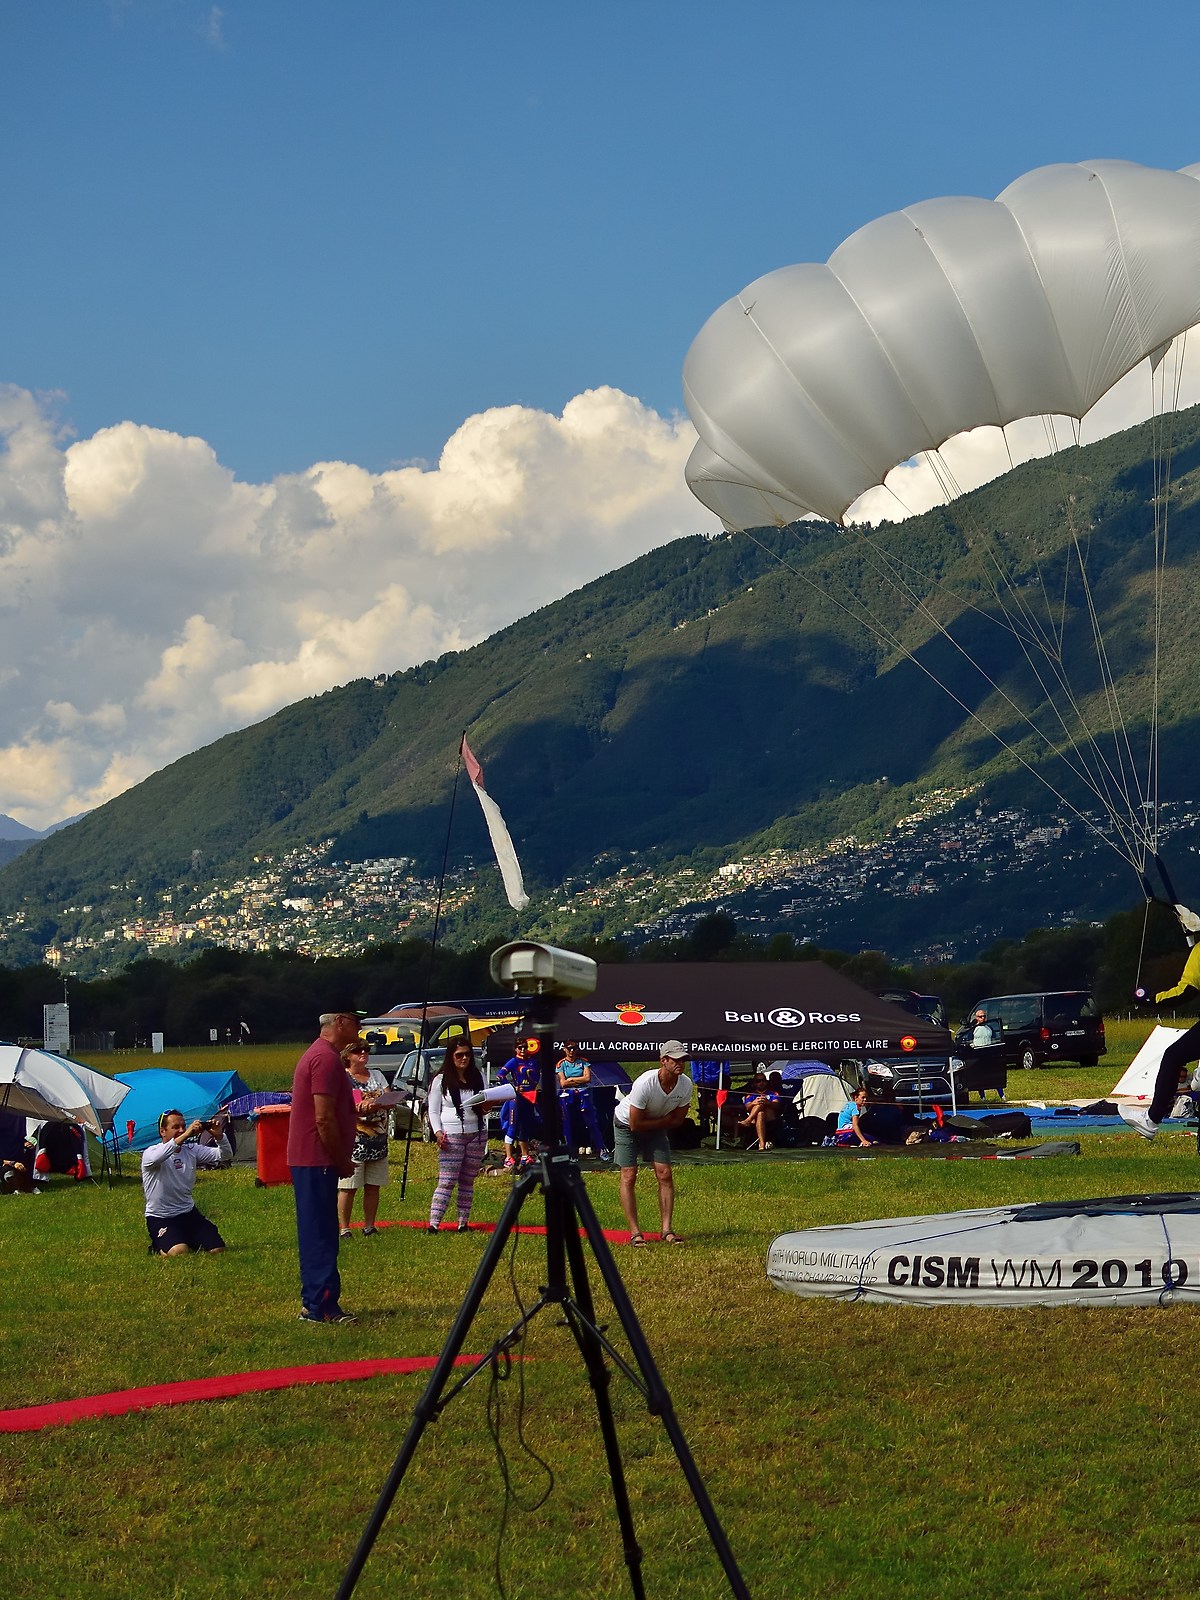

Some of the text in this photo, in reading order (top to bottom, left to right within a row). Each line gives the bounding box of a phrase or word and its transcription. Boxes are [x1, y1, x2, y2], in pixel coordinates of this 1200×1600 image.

[725, 1009, 861, 1026] Bell & Ross
[553, 1041, 606, 1051] PAULLA
[691, 1042, 767, 1052] PARACAIDISMO
[770, 1042, 792, 1051] DEL
[792, 1041, 840, 1050] EJERCITO
[843, 1040, 862, 1049] DEL
[865, 1039, 889, 1049] AIRE
[785, 1250, 818, 1266] WORLD
[820, 1252, 881, 1270] MILITARY
[887, 1255, 1189, 1288] CISM WM 2010
